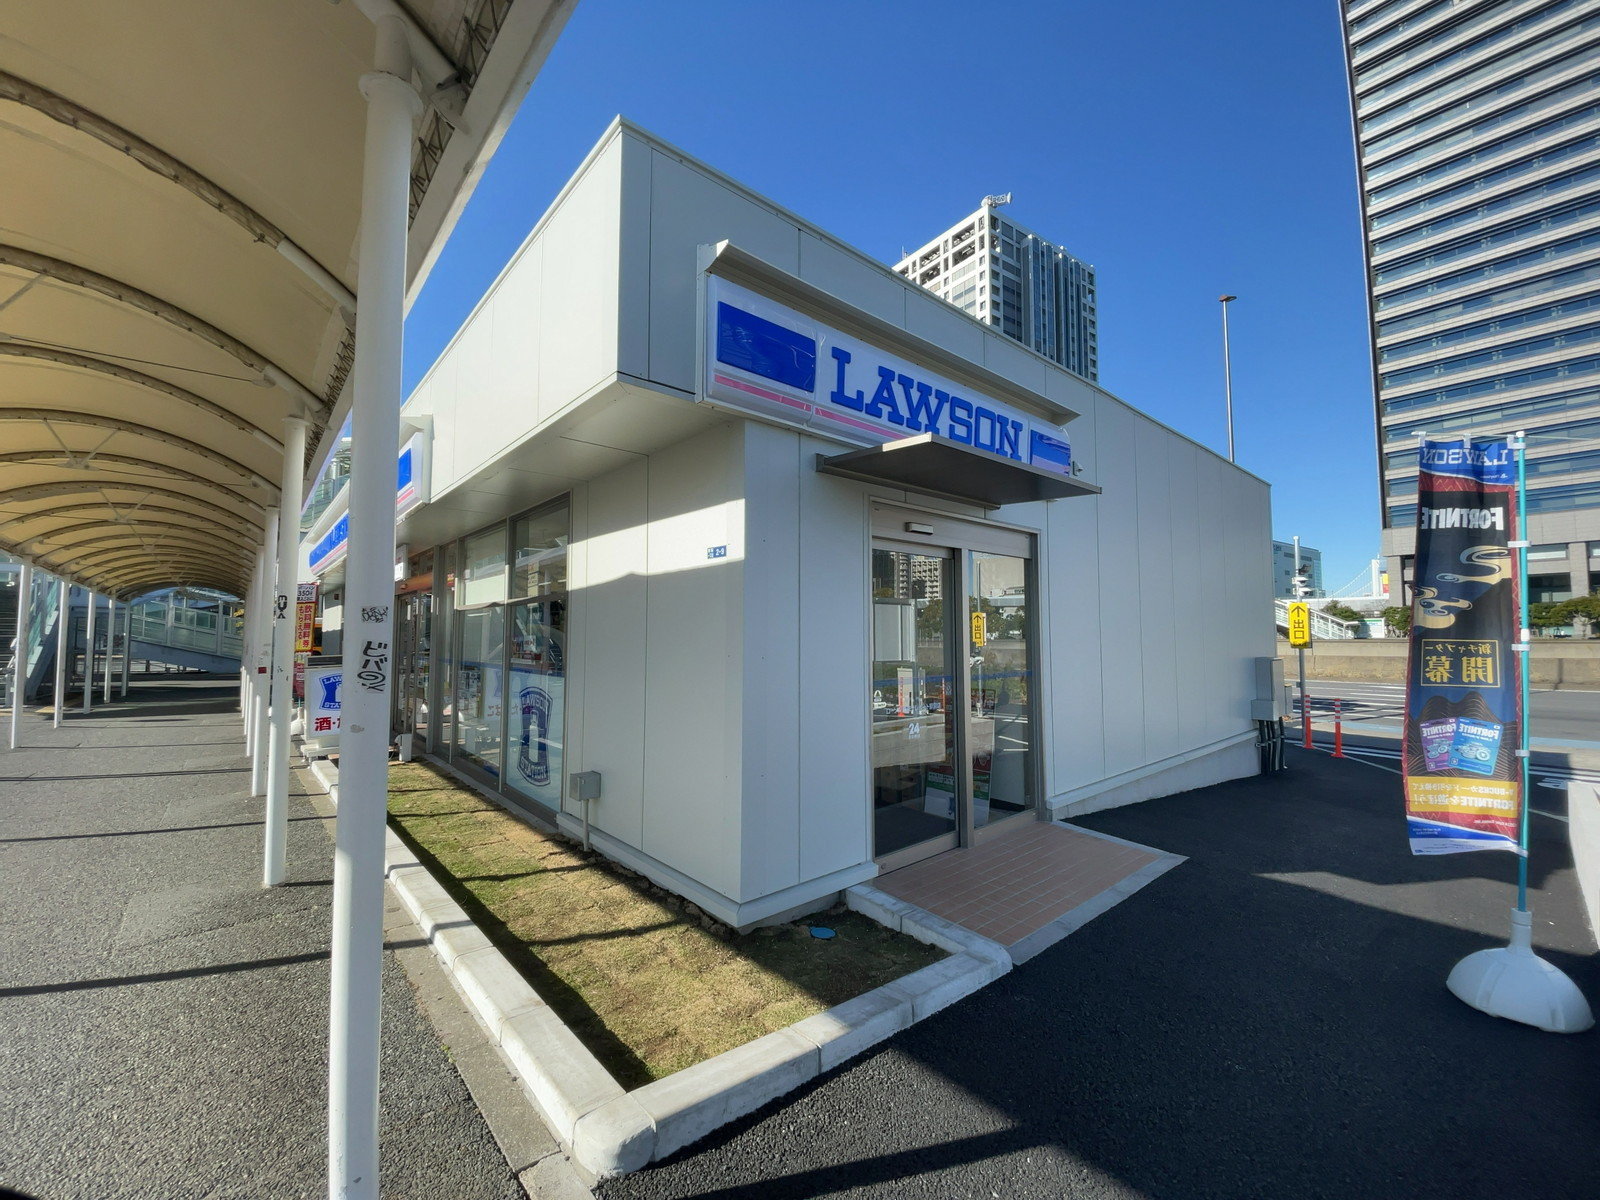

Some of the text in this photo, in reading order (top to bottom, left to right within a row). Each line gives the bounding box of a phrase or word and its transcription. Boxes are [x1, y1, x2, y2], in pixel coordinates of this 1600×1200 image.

[830, 346, 1024, 462] LAWSON
[1293, 618, 1305, 639] 出口
[908, 722, 920, 735] 24
